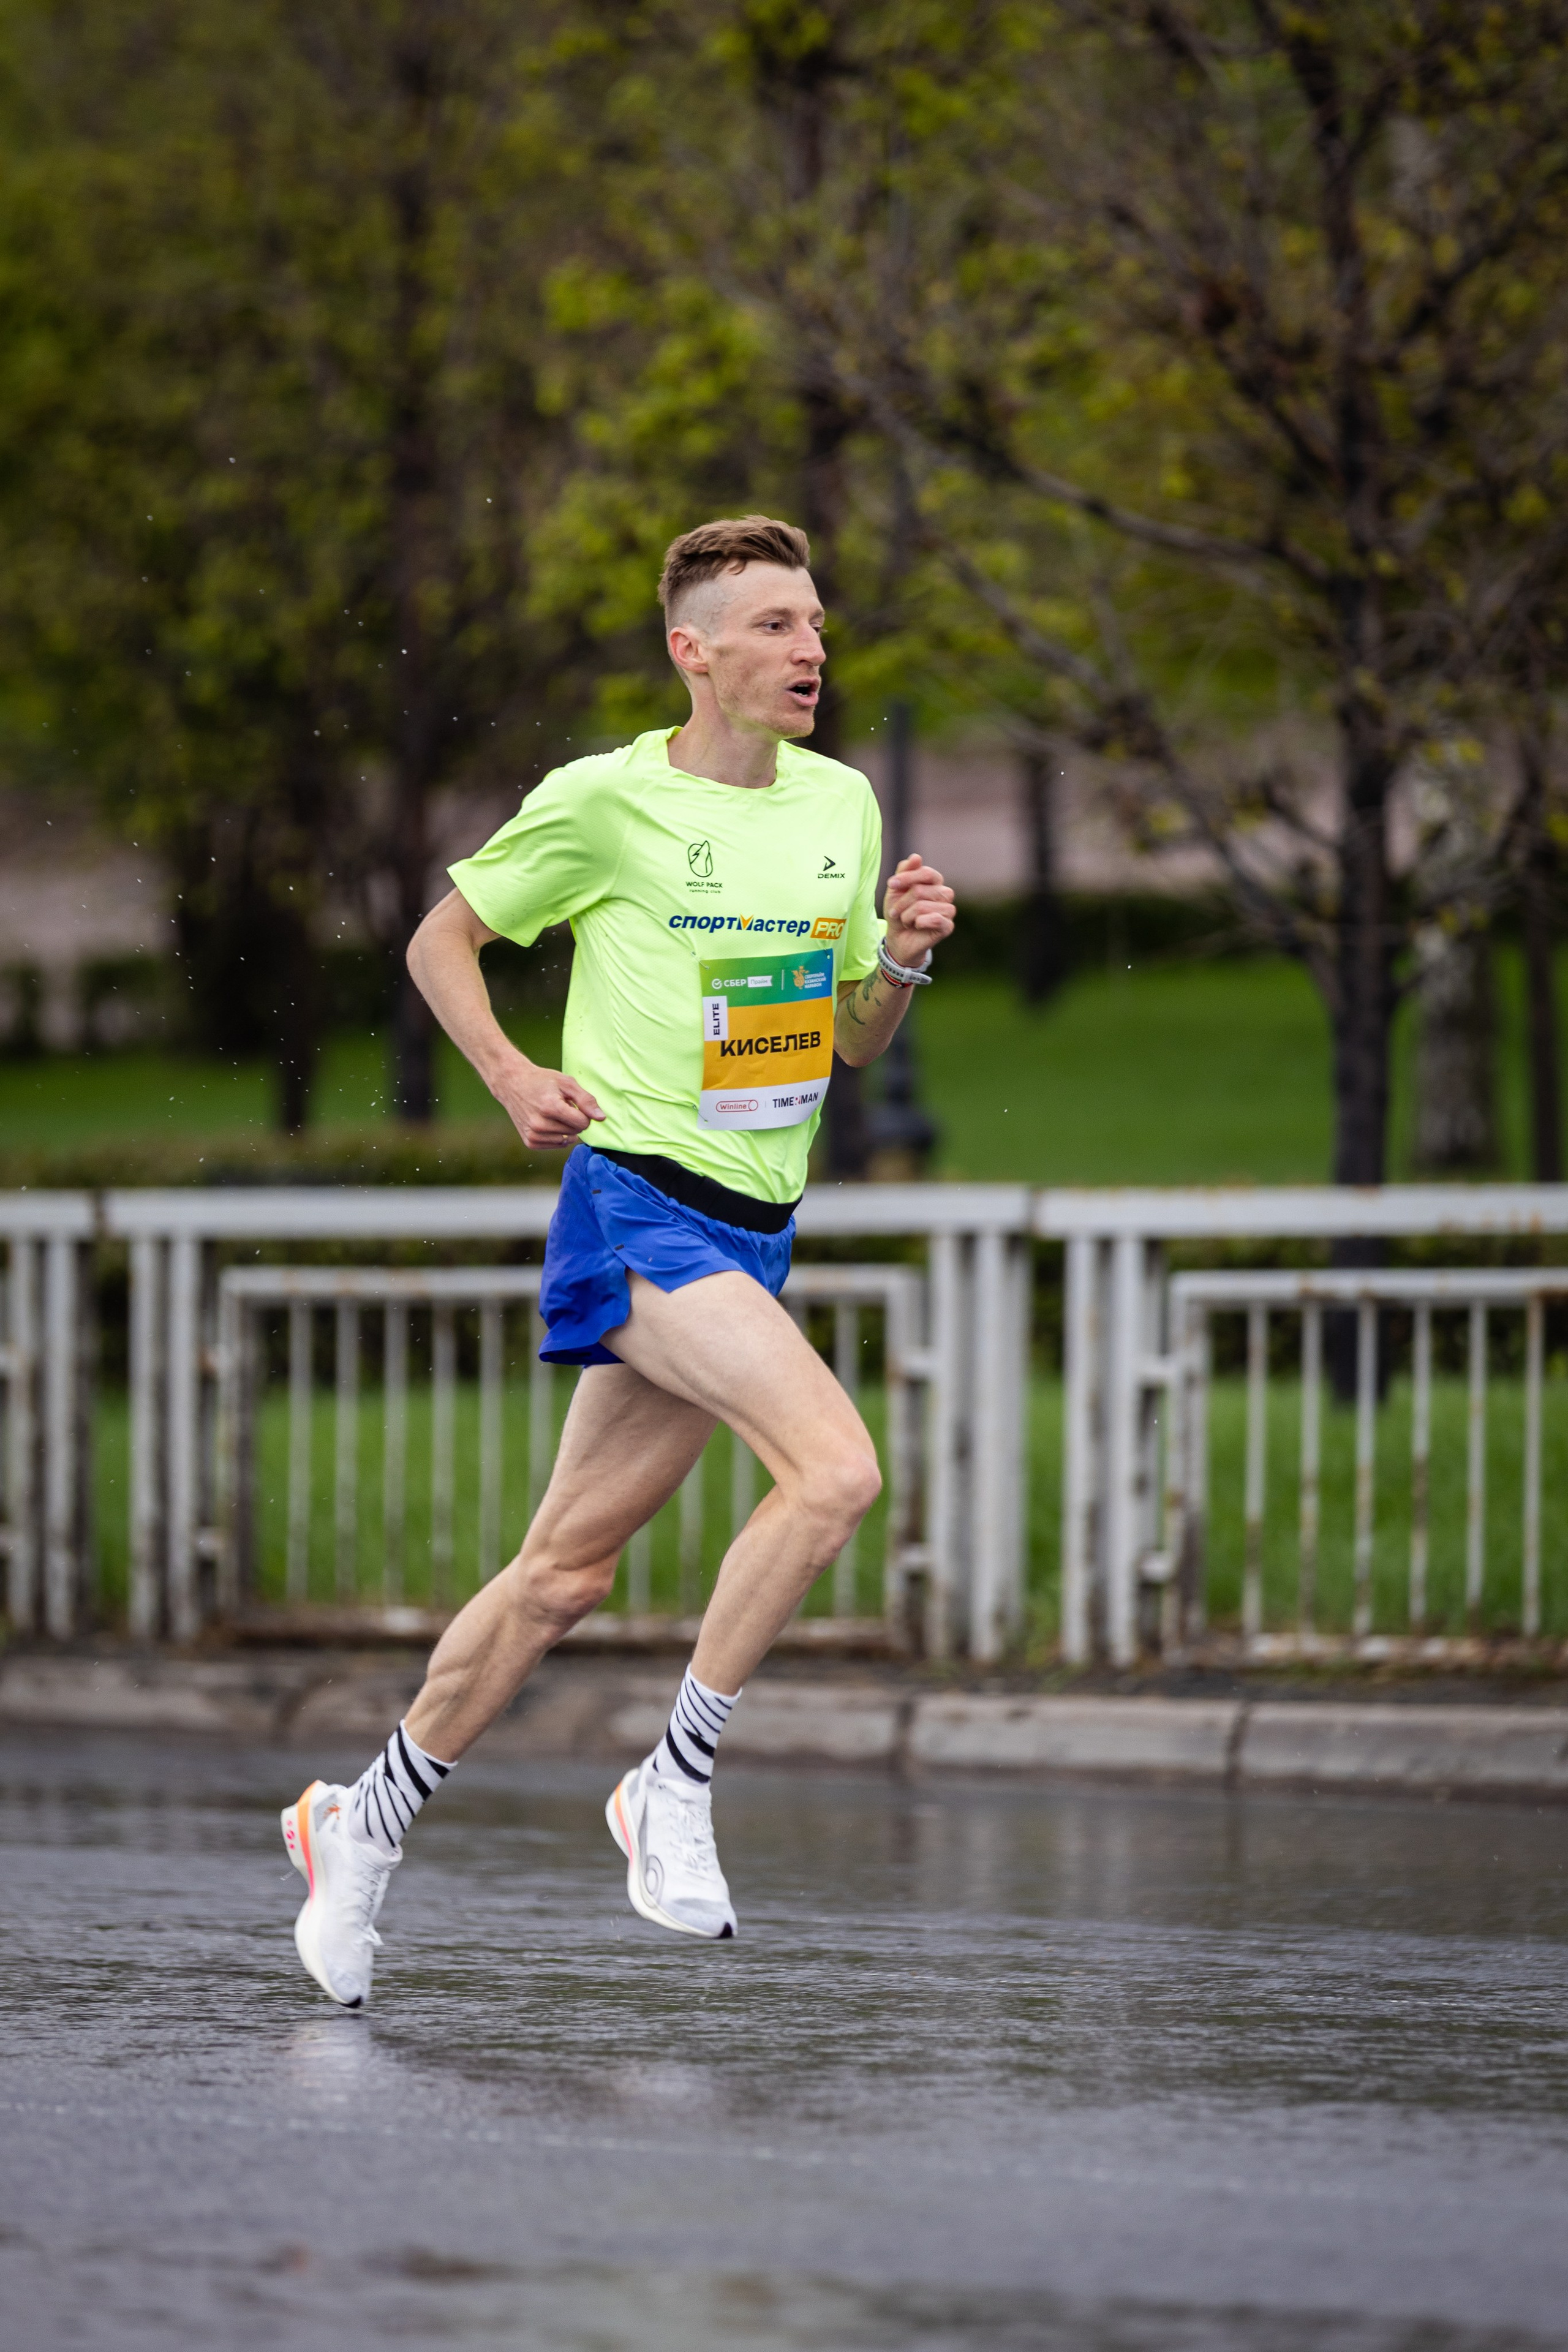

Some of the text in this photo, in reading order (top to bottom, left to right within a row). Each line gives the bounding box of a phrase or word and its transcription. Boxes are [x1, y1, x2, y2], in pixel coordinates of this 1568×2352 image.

[815, 921, 844, 937] PRO
[712, 1003, 720, 1036] ELITE
[720, 1031, 821, 1057] КИСЕЛЕВ
